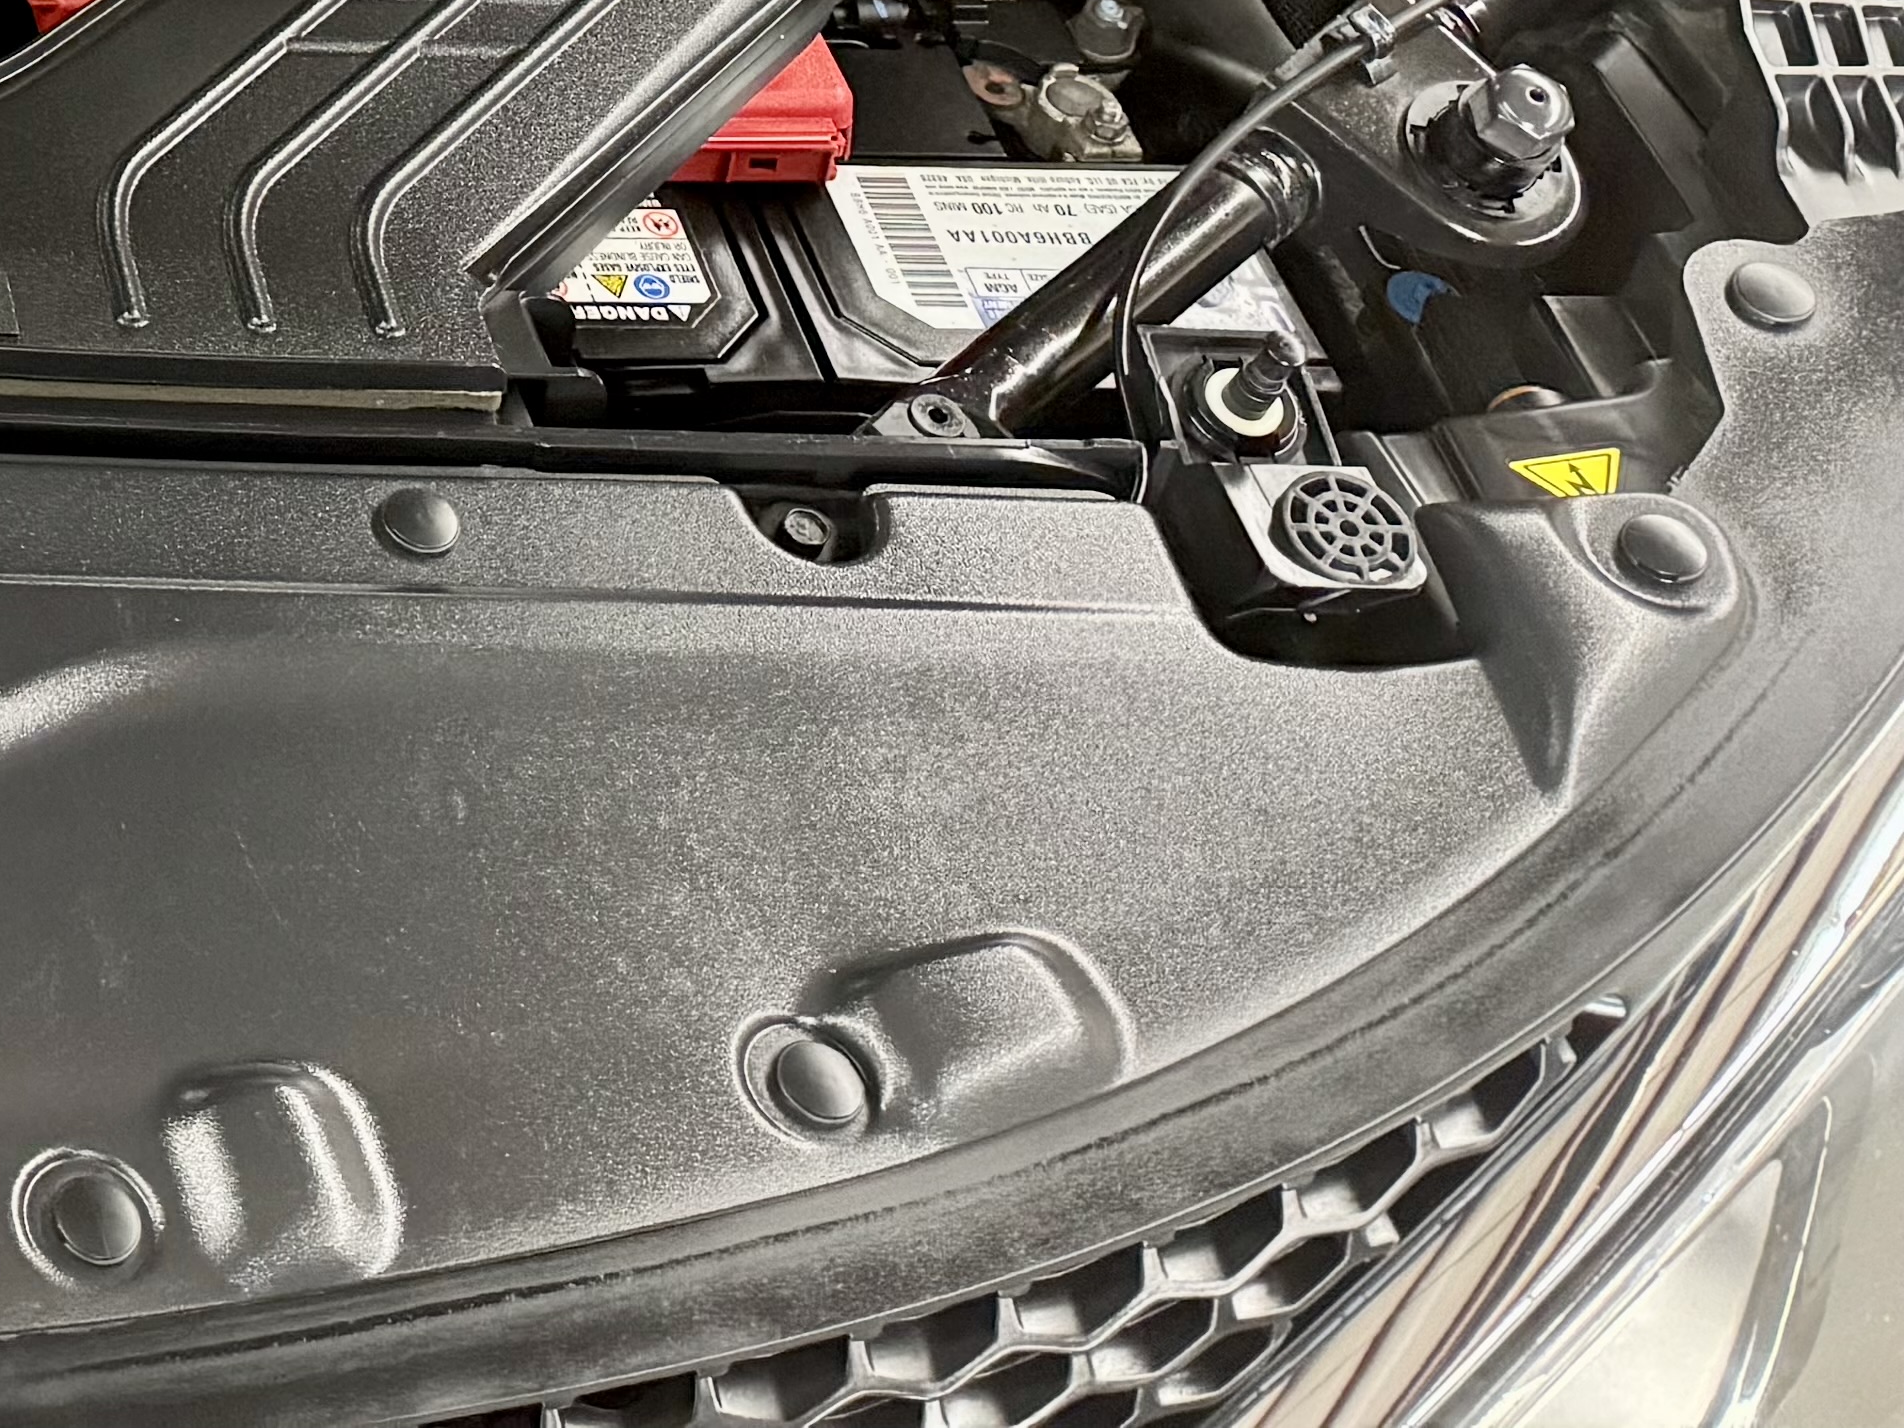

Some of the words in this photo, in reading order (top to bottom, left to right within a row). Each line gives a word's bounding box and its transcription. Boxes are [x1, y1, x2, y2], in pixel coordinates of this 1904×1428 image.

[971, 202, 1003, 216] 100
[1054, 204, 1078, 217] 70
[946, 229, 1092, 245] BBH6A001AA
[983, 282, 1019, 294] AGM
